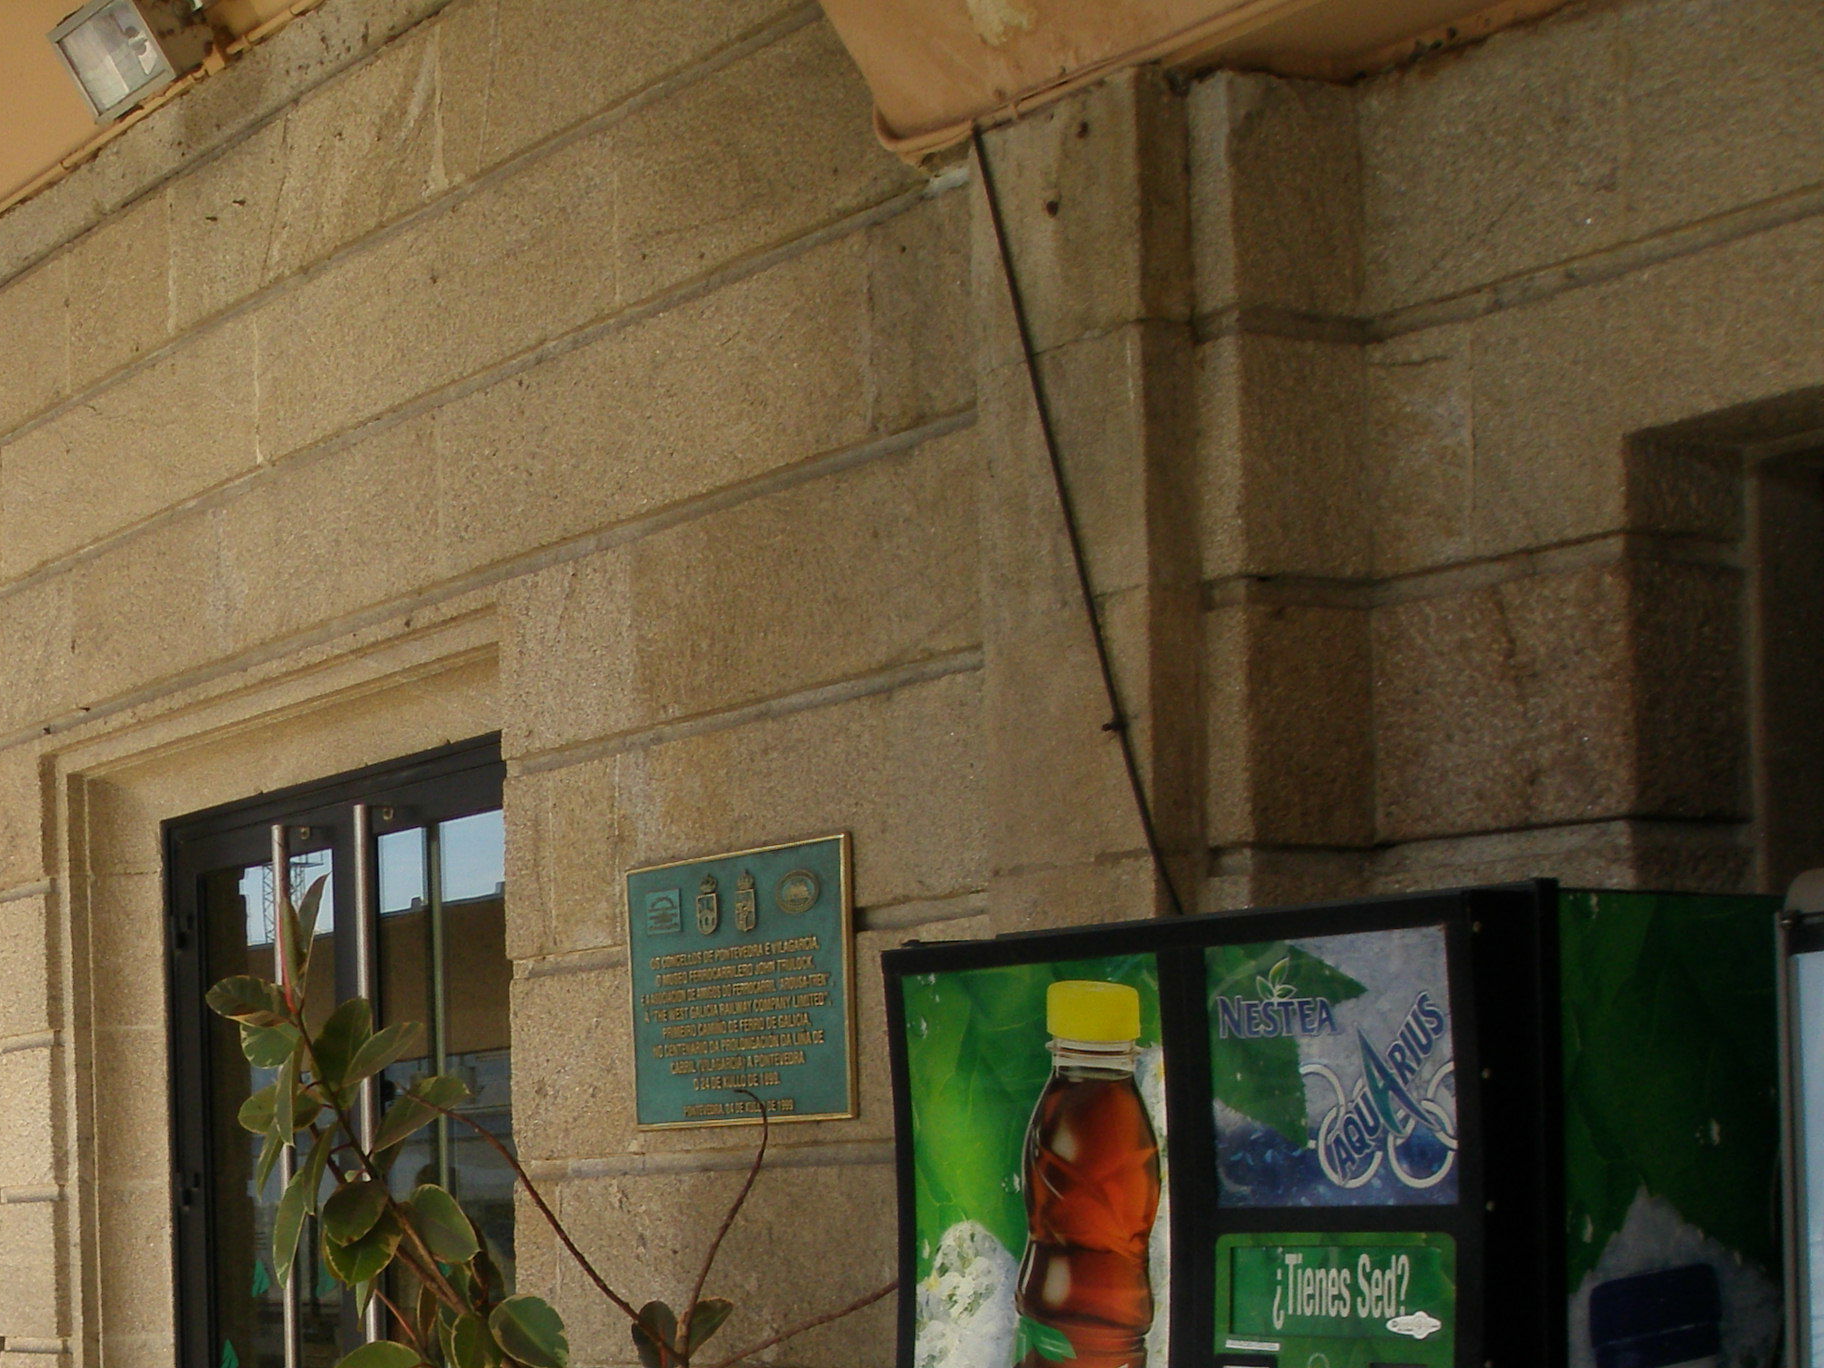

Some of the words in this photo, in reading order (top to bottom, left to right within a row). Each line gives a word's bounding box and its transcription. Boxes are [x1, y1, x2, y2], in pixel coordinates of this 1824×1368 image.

[703, 950, 714, 963] DE
[716, 944, 763, 961] PONTEVEDRA
[764, 942, 772, 955] E
[668, 1007, 688, 1020] WEST
[689, 1003, 718, 1018] GALICIA
[719, 1000, 753, 1016] RAILWAY
[752, 995, 791, 1012] COMPANY
[1215, 994, 1345, 1040] NESTEA
[727, 1019, 738, 1033] DE
[739, 1017, 764, 1032] FERRO
[766, 1015, 777, 1030] DE
[812, 1029, 824, 1044] DE
[710, 1076, 722, 1089] DE
[747, 1072, 759, 1087] DE
[1326, 991, 1444, 1183] AQUARIUS
[1272, 1253, 1351, 1330] ¿Tienes
[1356, 1253, 1410, 1319] Sed?
